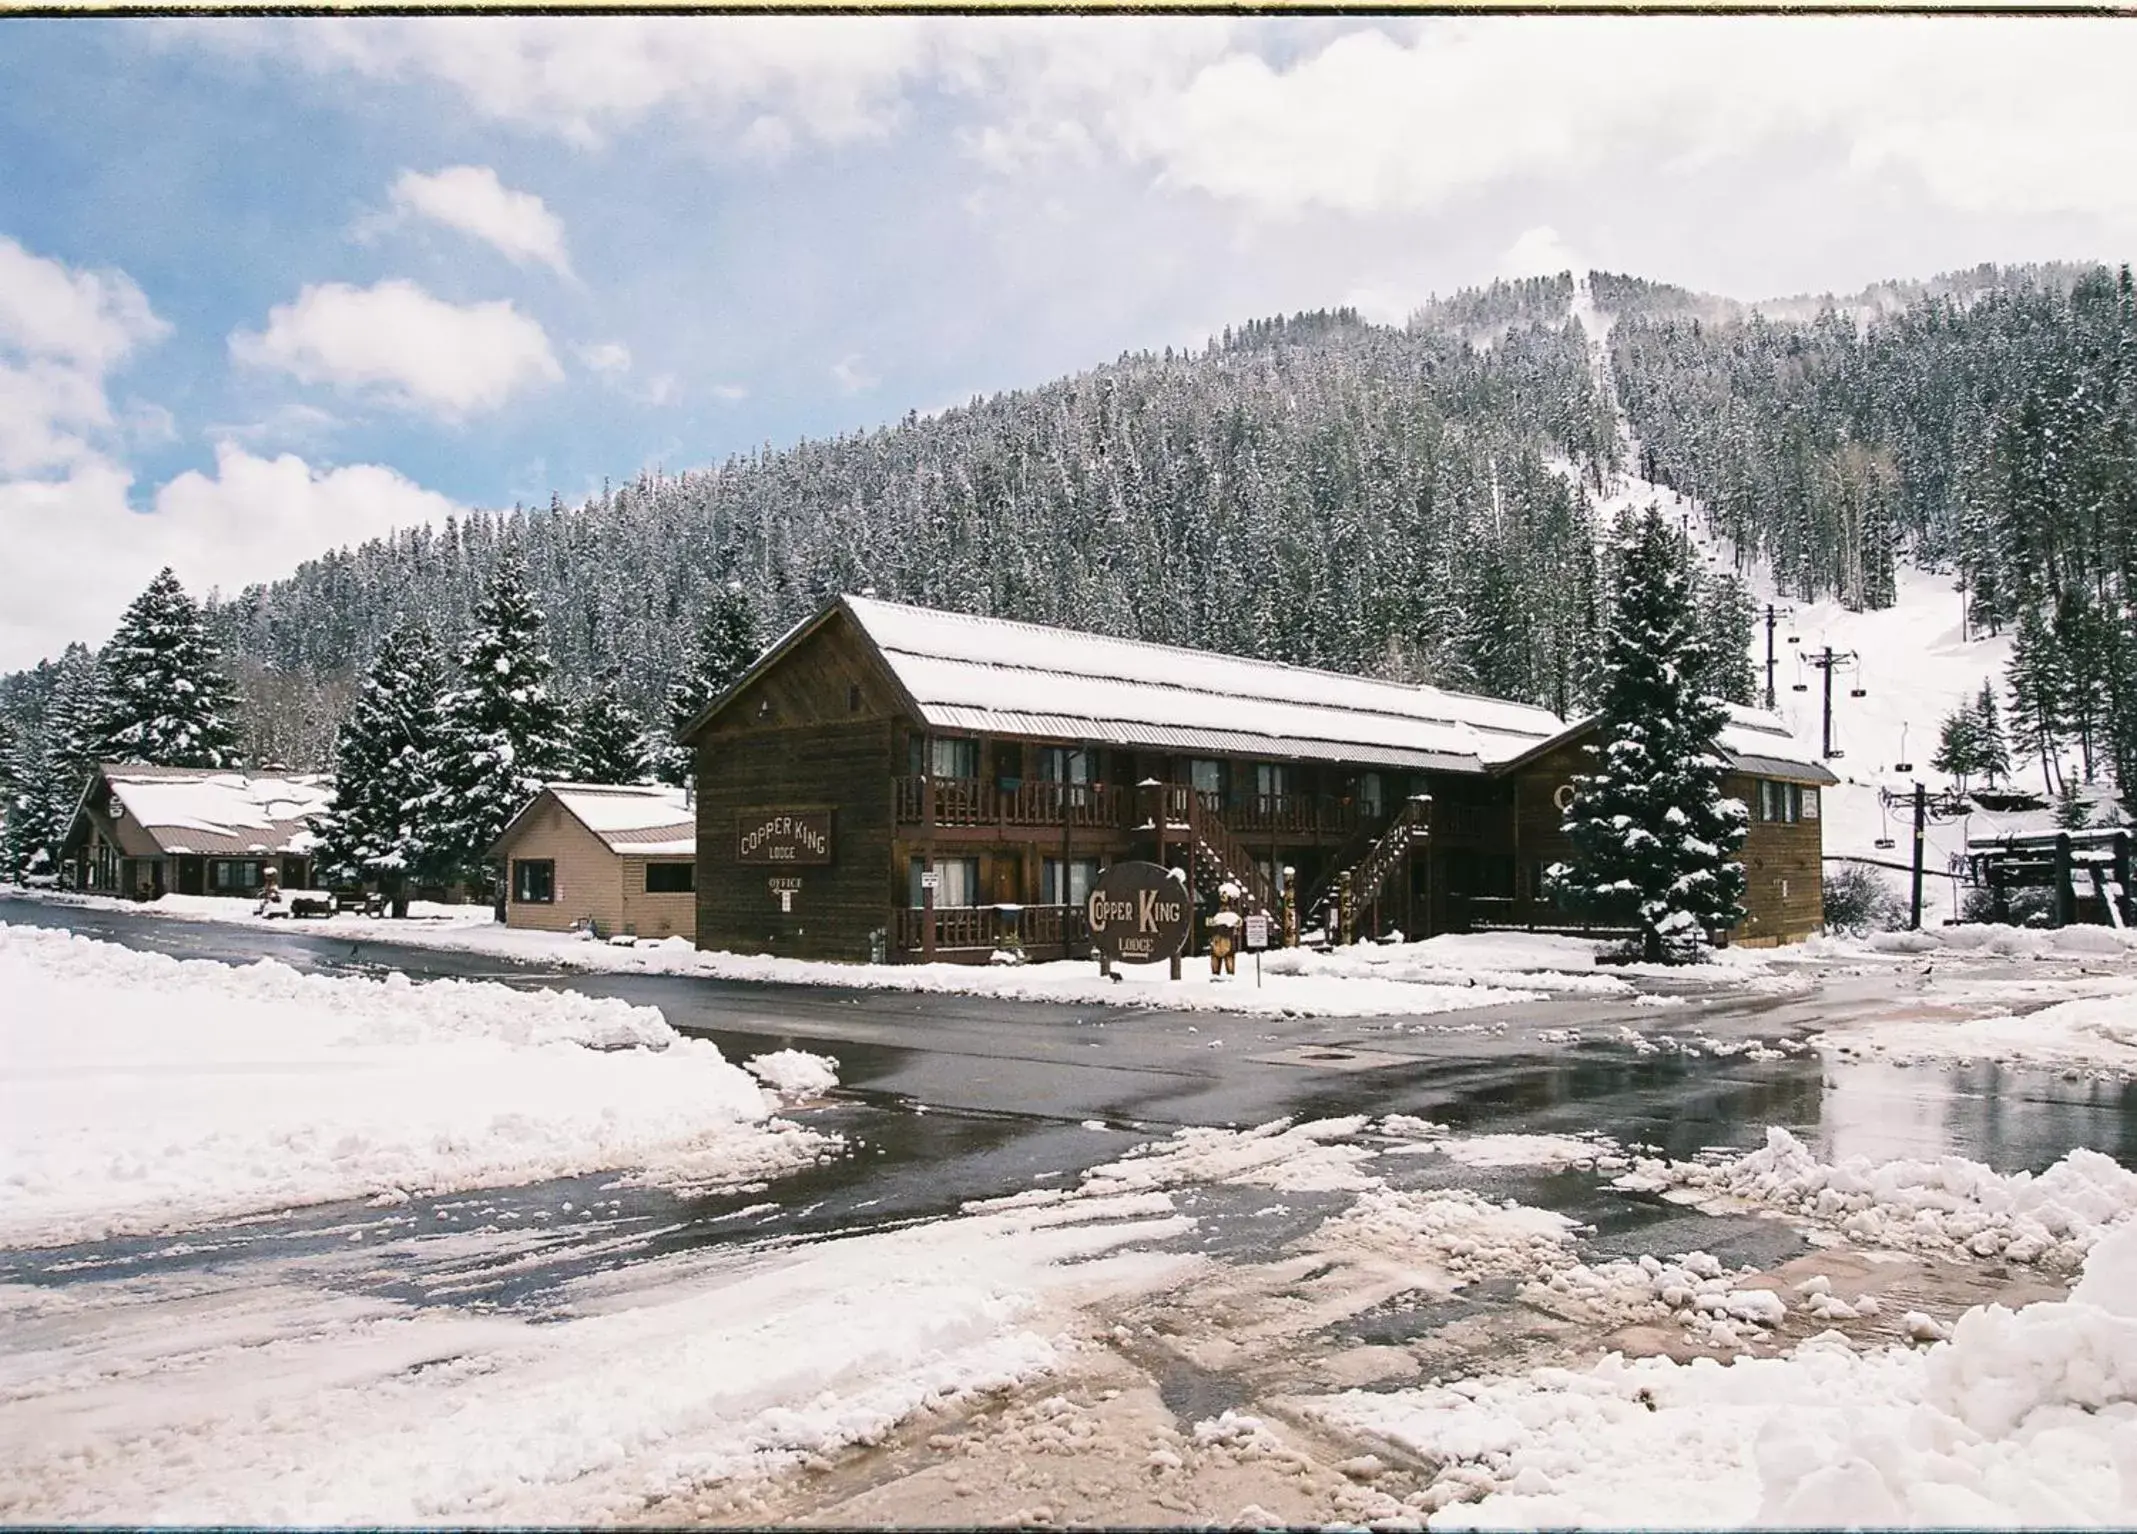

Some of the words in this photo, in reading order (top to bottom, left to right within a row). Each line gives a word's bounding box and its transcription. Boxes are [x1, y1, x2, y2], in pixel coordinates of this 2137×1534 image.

[741, 817, 791, 855] COPPER
[794, 821, 825, 854] KING
[769, 847, 796, 859] LODGE
[768, 878, 802, 888] OFFICE
[1118, 937, 1154, 952] LODGE
